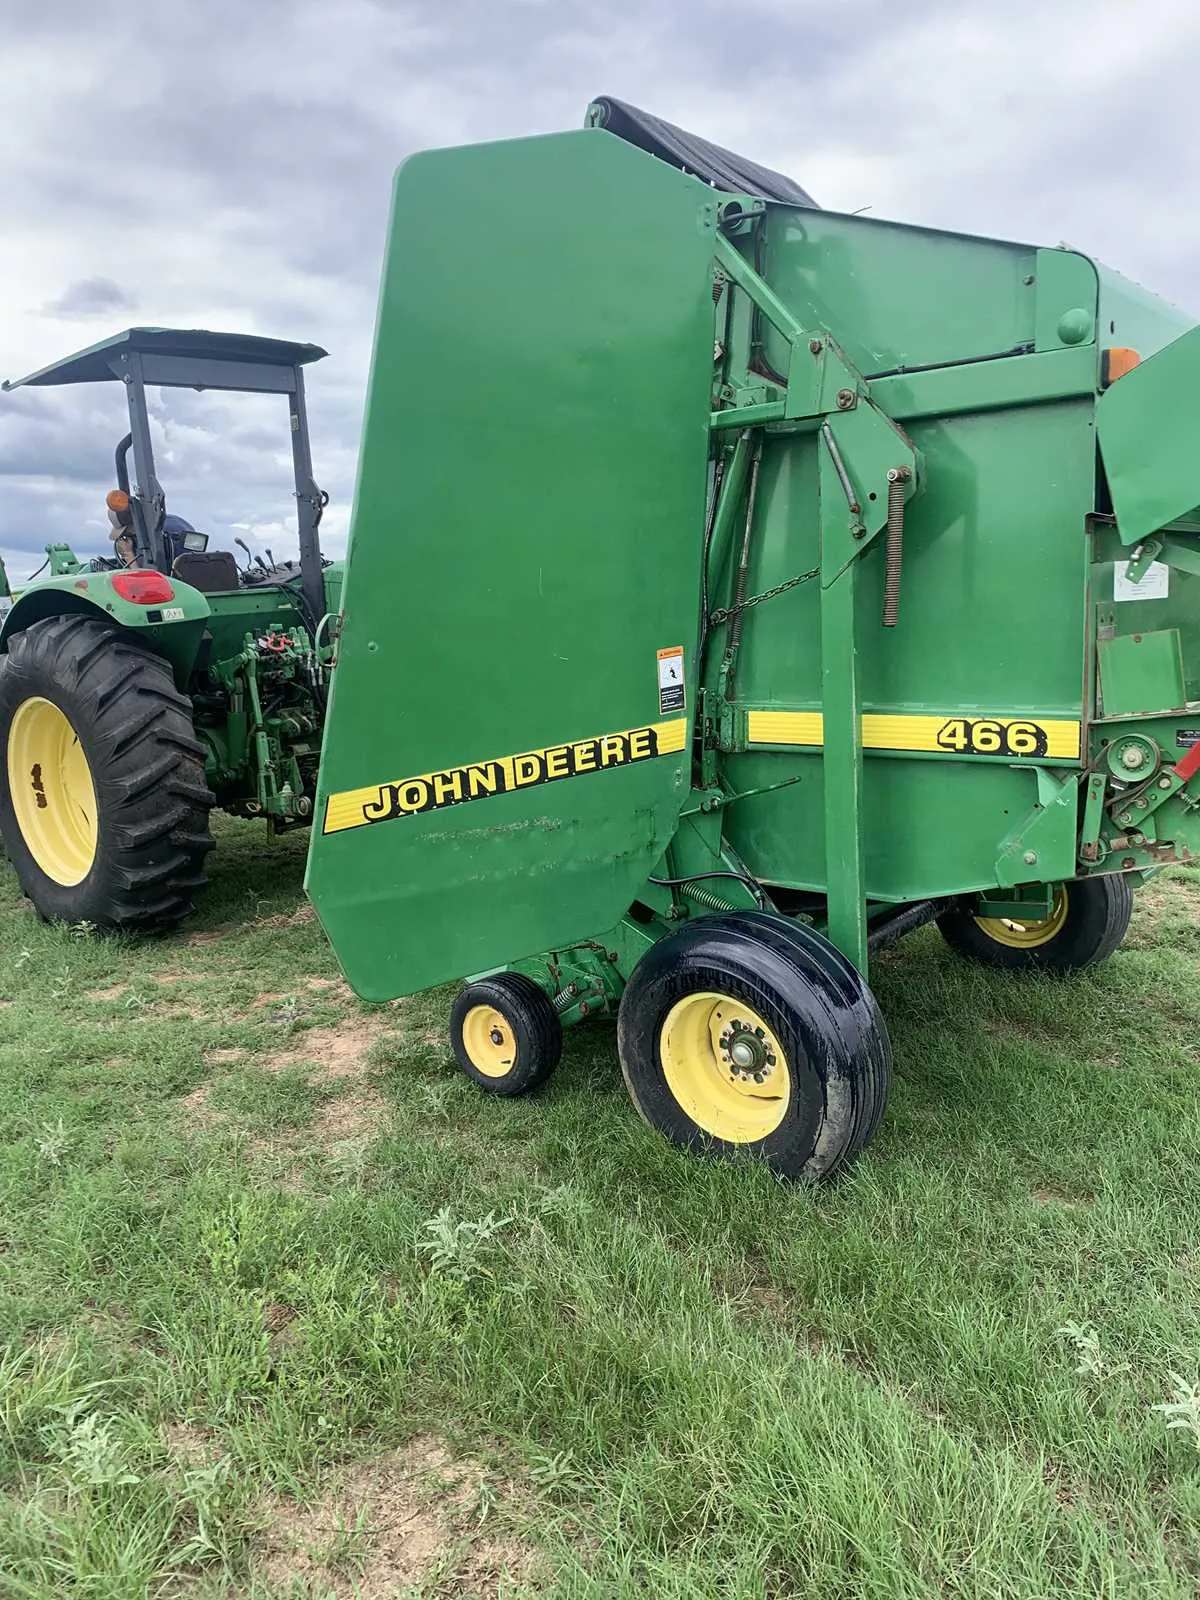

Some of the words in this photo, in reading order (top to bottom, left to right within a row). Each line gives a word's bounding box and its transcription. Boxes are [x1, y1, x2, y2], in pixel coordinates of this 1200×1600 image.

[937, 719, 1047, 757] 466
[363, 763, 502, 822] JOHN
[514, 728, 657, 787] DEERE
